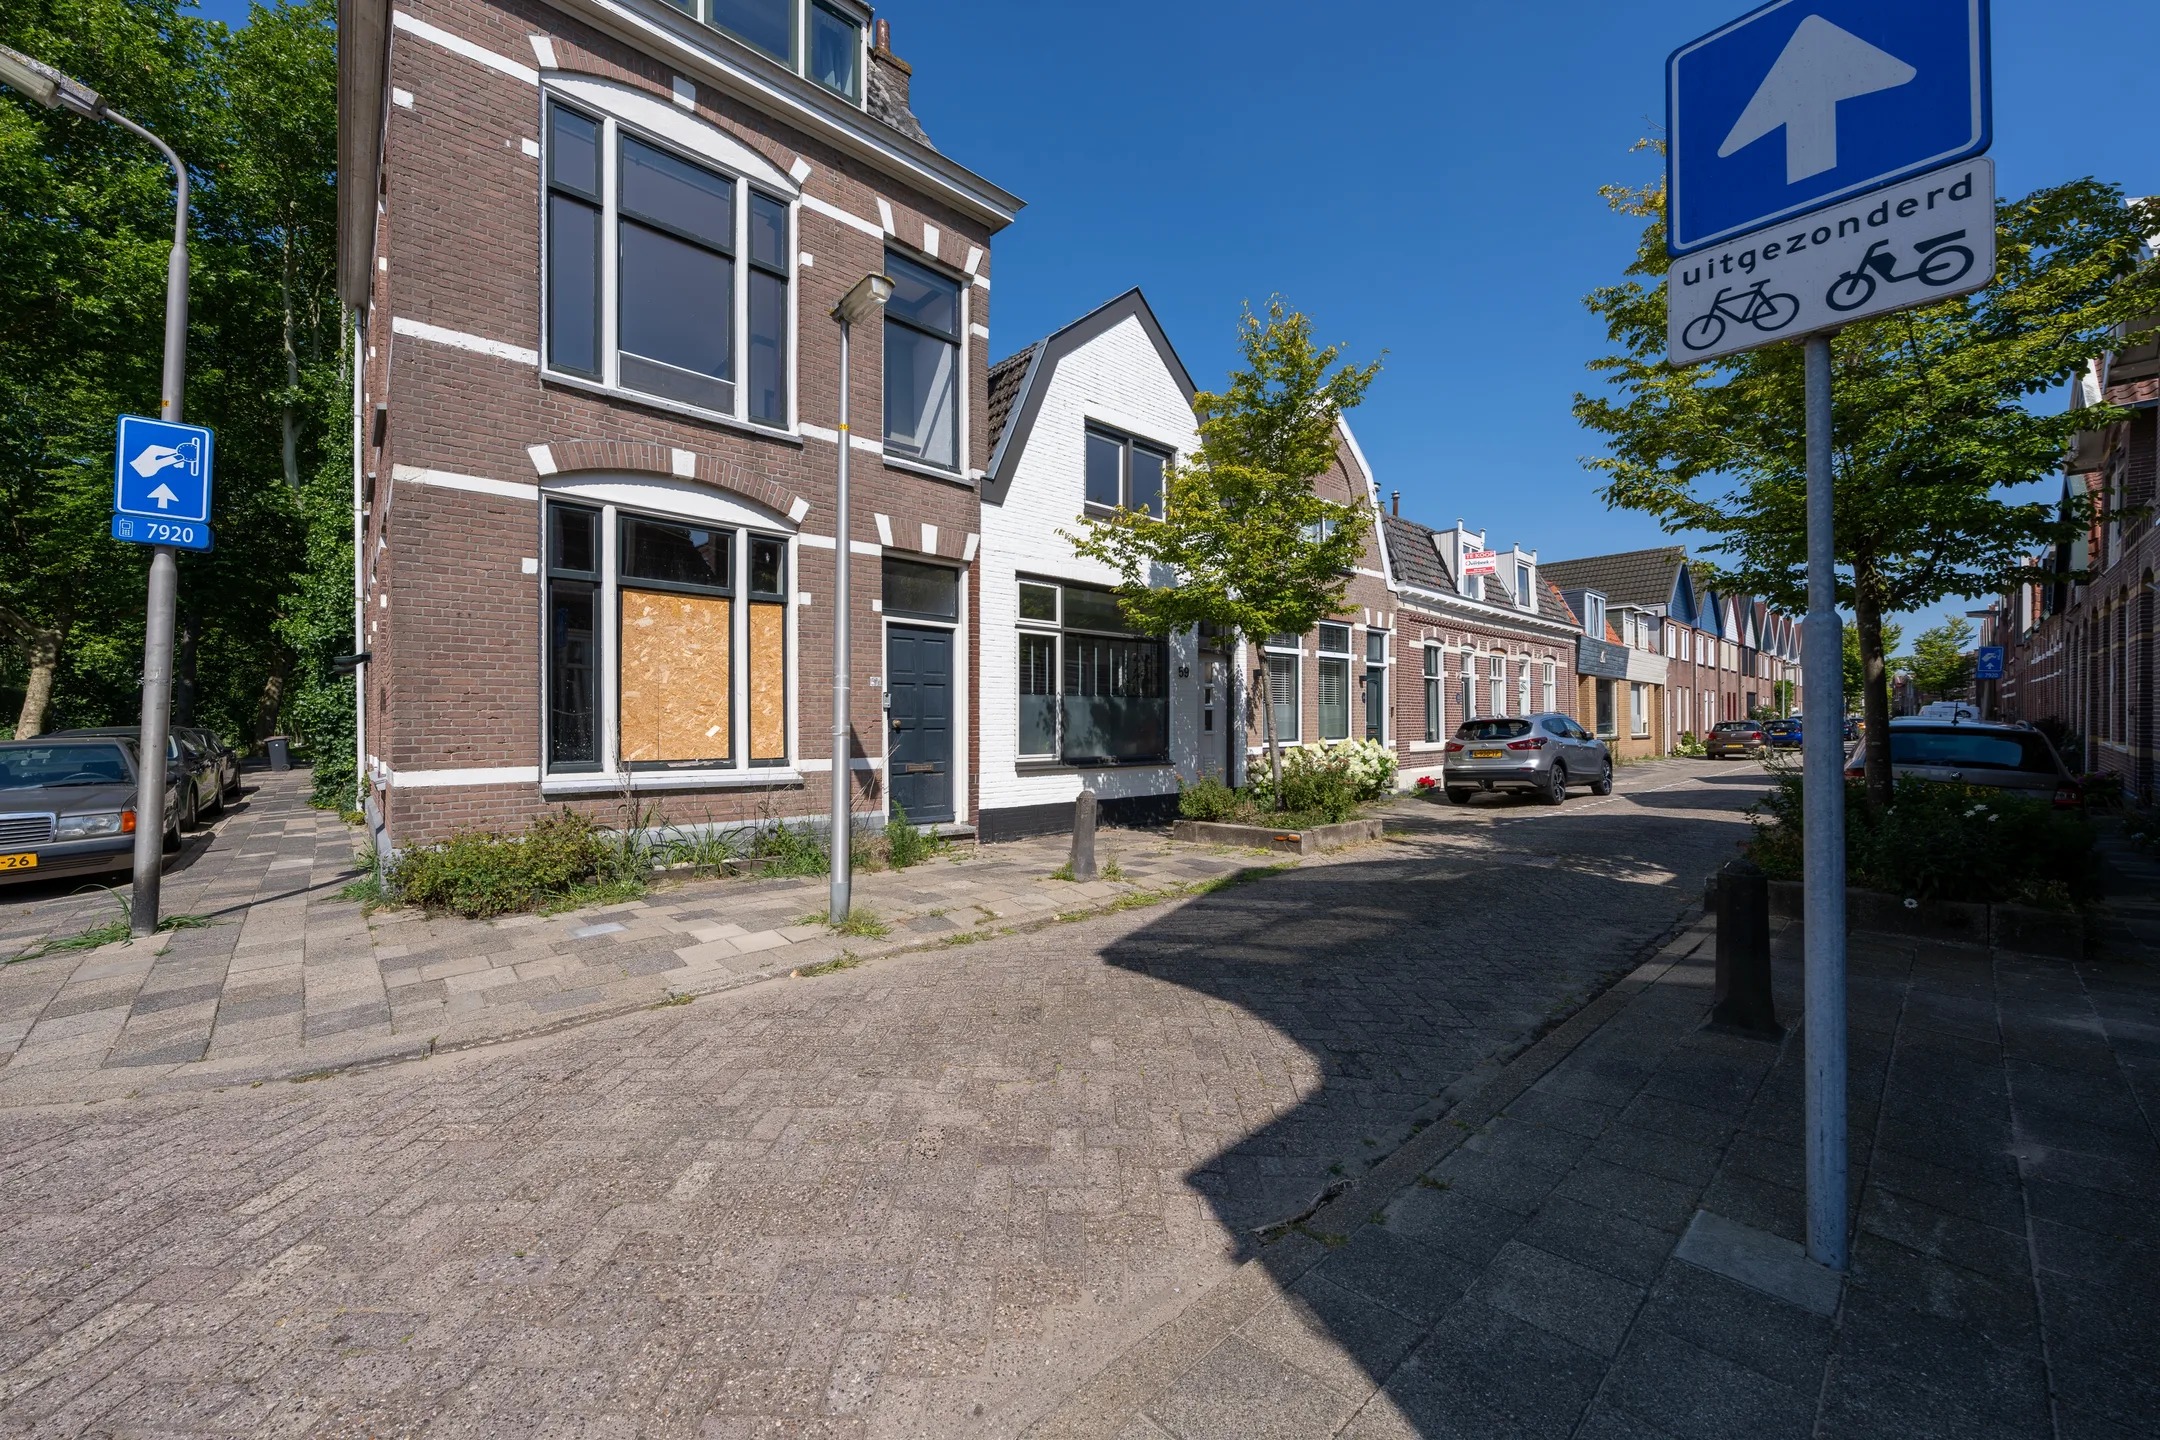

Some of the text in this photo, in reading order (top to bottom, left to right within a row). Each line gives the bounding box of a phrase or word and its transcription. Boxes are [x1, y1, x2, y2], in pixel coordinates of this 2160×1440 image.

[1682, 172, 1972, 286] uitgezonderd
[147, 523, 194, 543] 7920
[1178, 666, 1189, 678] 59
